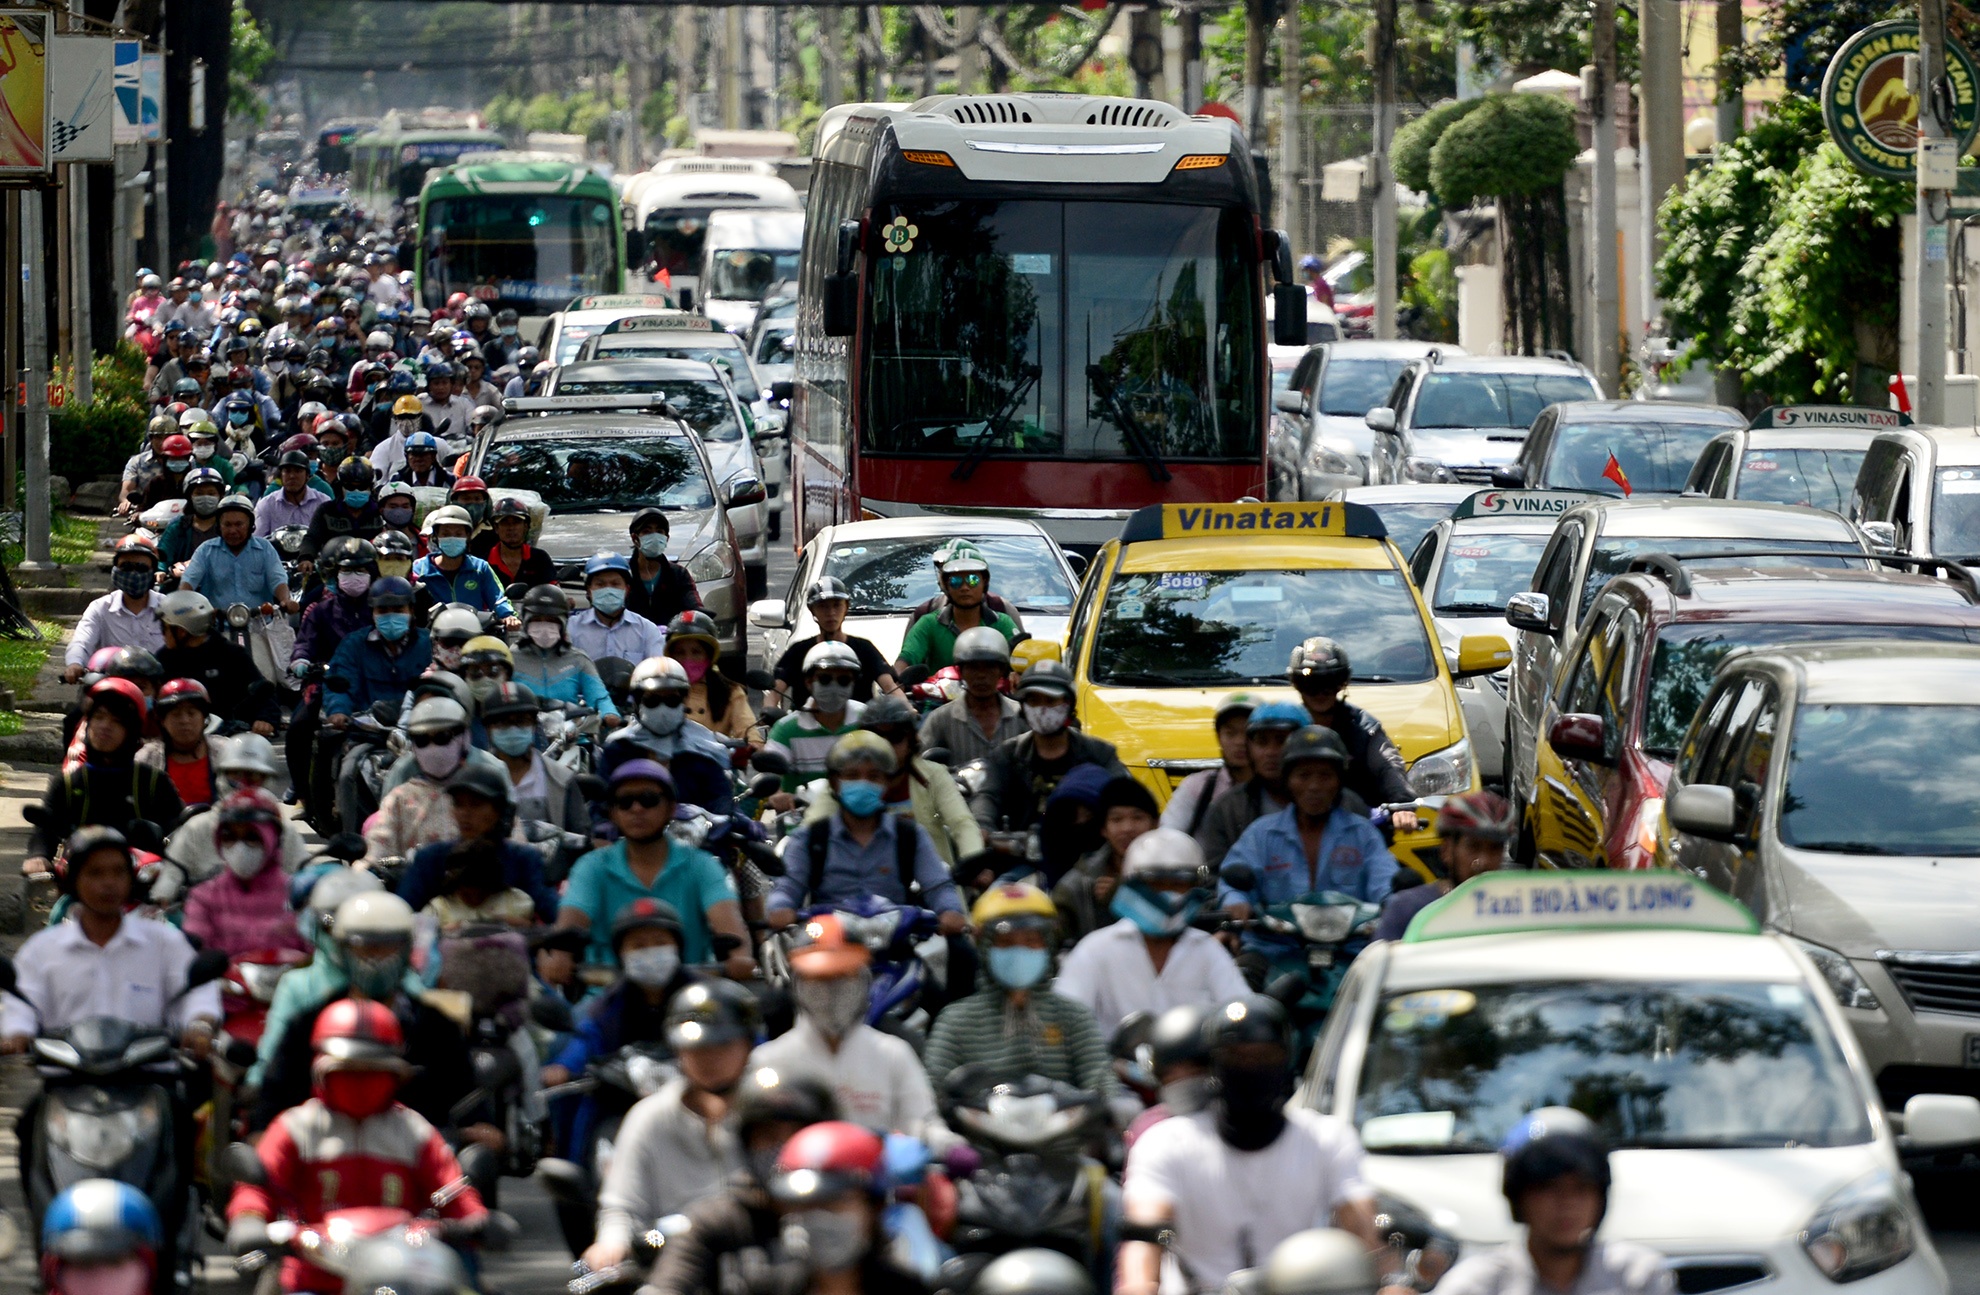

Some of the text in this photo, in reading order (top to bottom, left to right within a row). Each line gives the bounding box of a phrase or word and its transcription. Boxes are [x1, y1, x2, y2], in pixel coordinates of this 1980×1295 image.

[1835, 33, 1974, 106] GOLDEN MOTAIN
[1852, 134, 1907, 168] COFFEE
[894, 230, 905, 243] B
[641, 319, 709, 329] VINASUN TAXI
[1178, 506, 1331, 531] Vinataxi
[1161, 577, 1203, 588] 5080
[1472, 887, 1523, 917] Taxi
[1626, 881, 1695, 912] LONG
